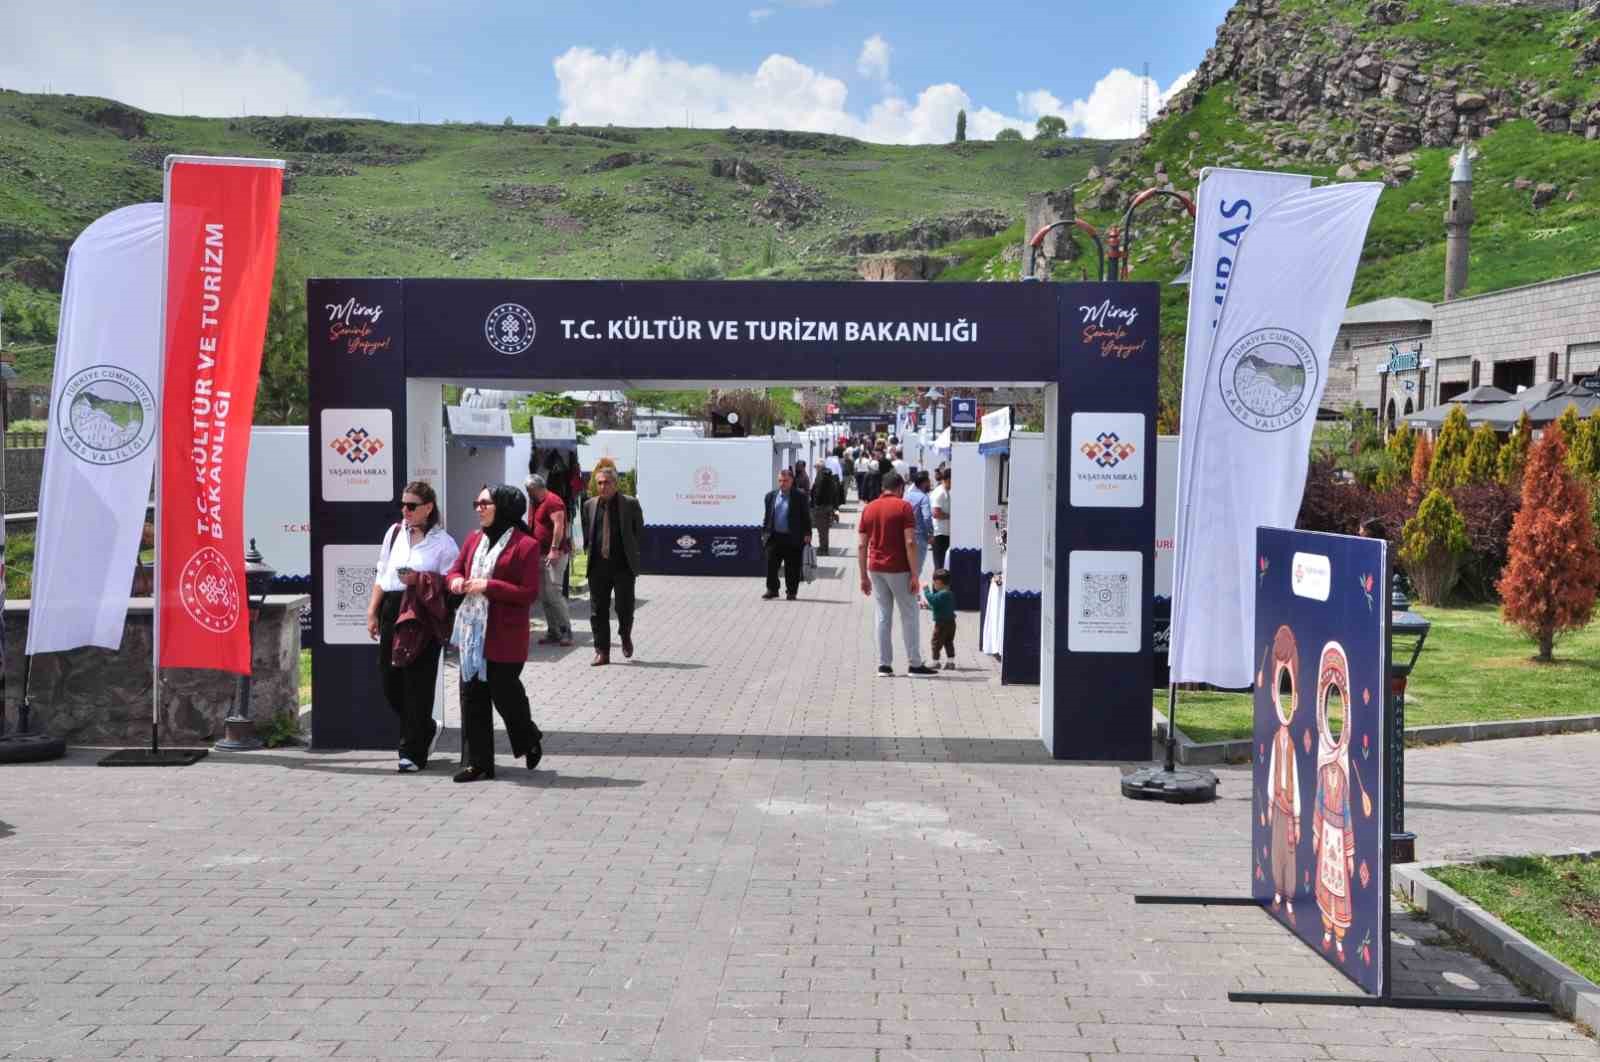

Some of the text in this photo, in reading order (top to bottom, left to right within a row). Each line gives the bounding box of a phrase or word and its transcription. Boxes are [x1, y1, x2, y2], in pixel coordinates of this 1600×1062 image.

[1212, 199, 1252, 329] RAS
[325, 297, 384, 326] Miras
[560, 316, 977, 342] T.C. KÜLTÜR VE TURİZM BAKANLIĞI
[1079, 298, 1139, 328] Miras
[191, 223, 224, 535] T.C. KÜLTÜR VE TURİZM
[209, 391, 231, 540] BAKANLIĞI
